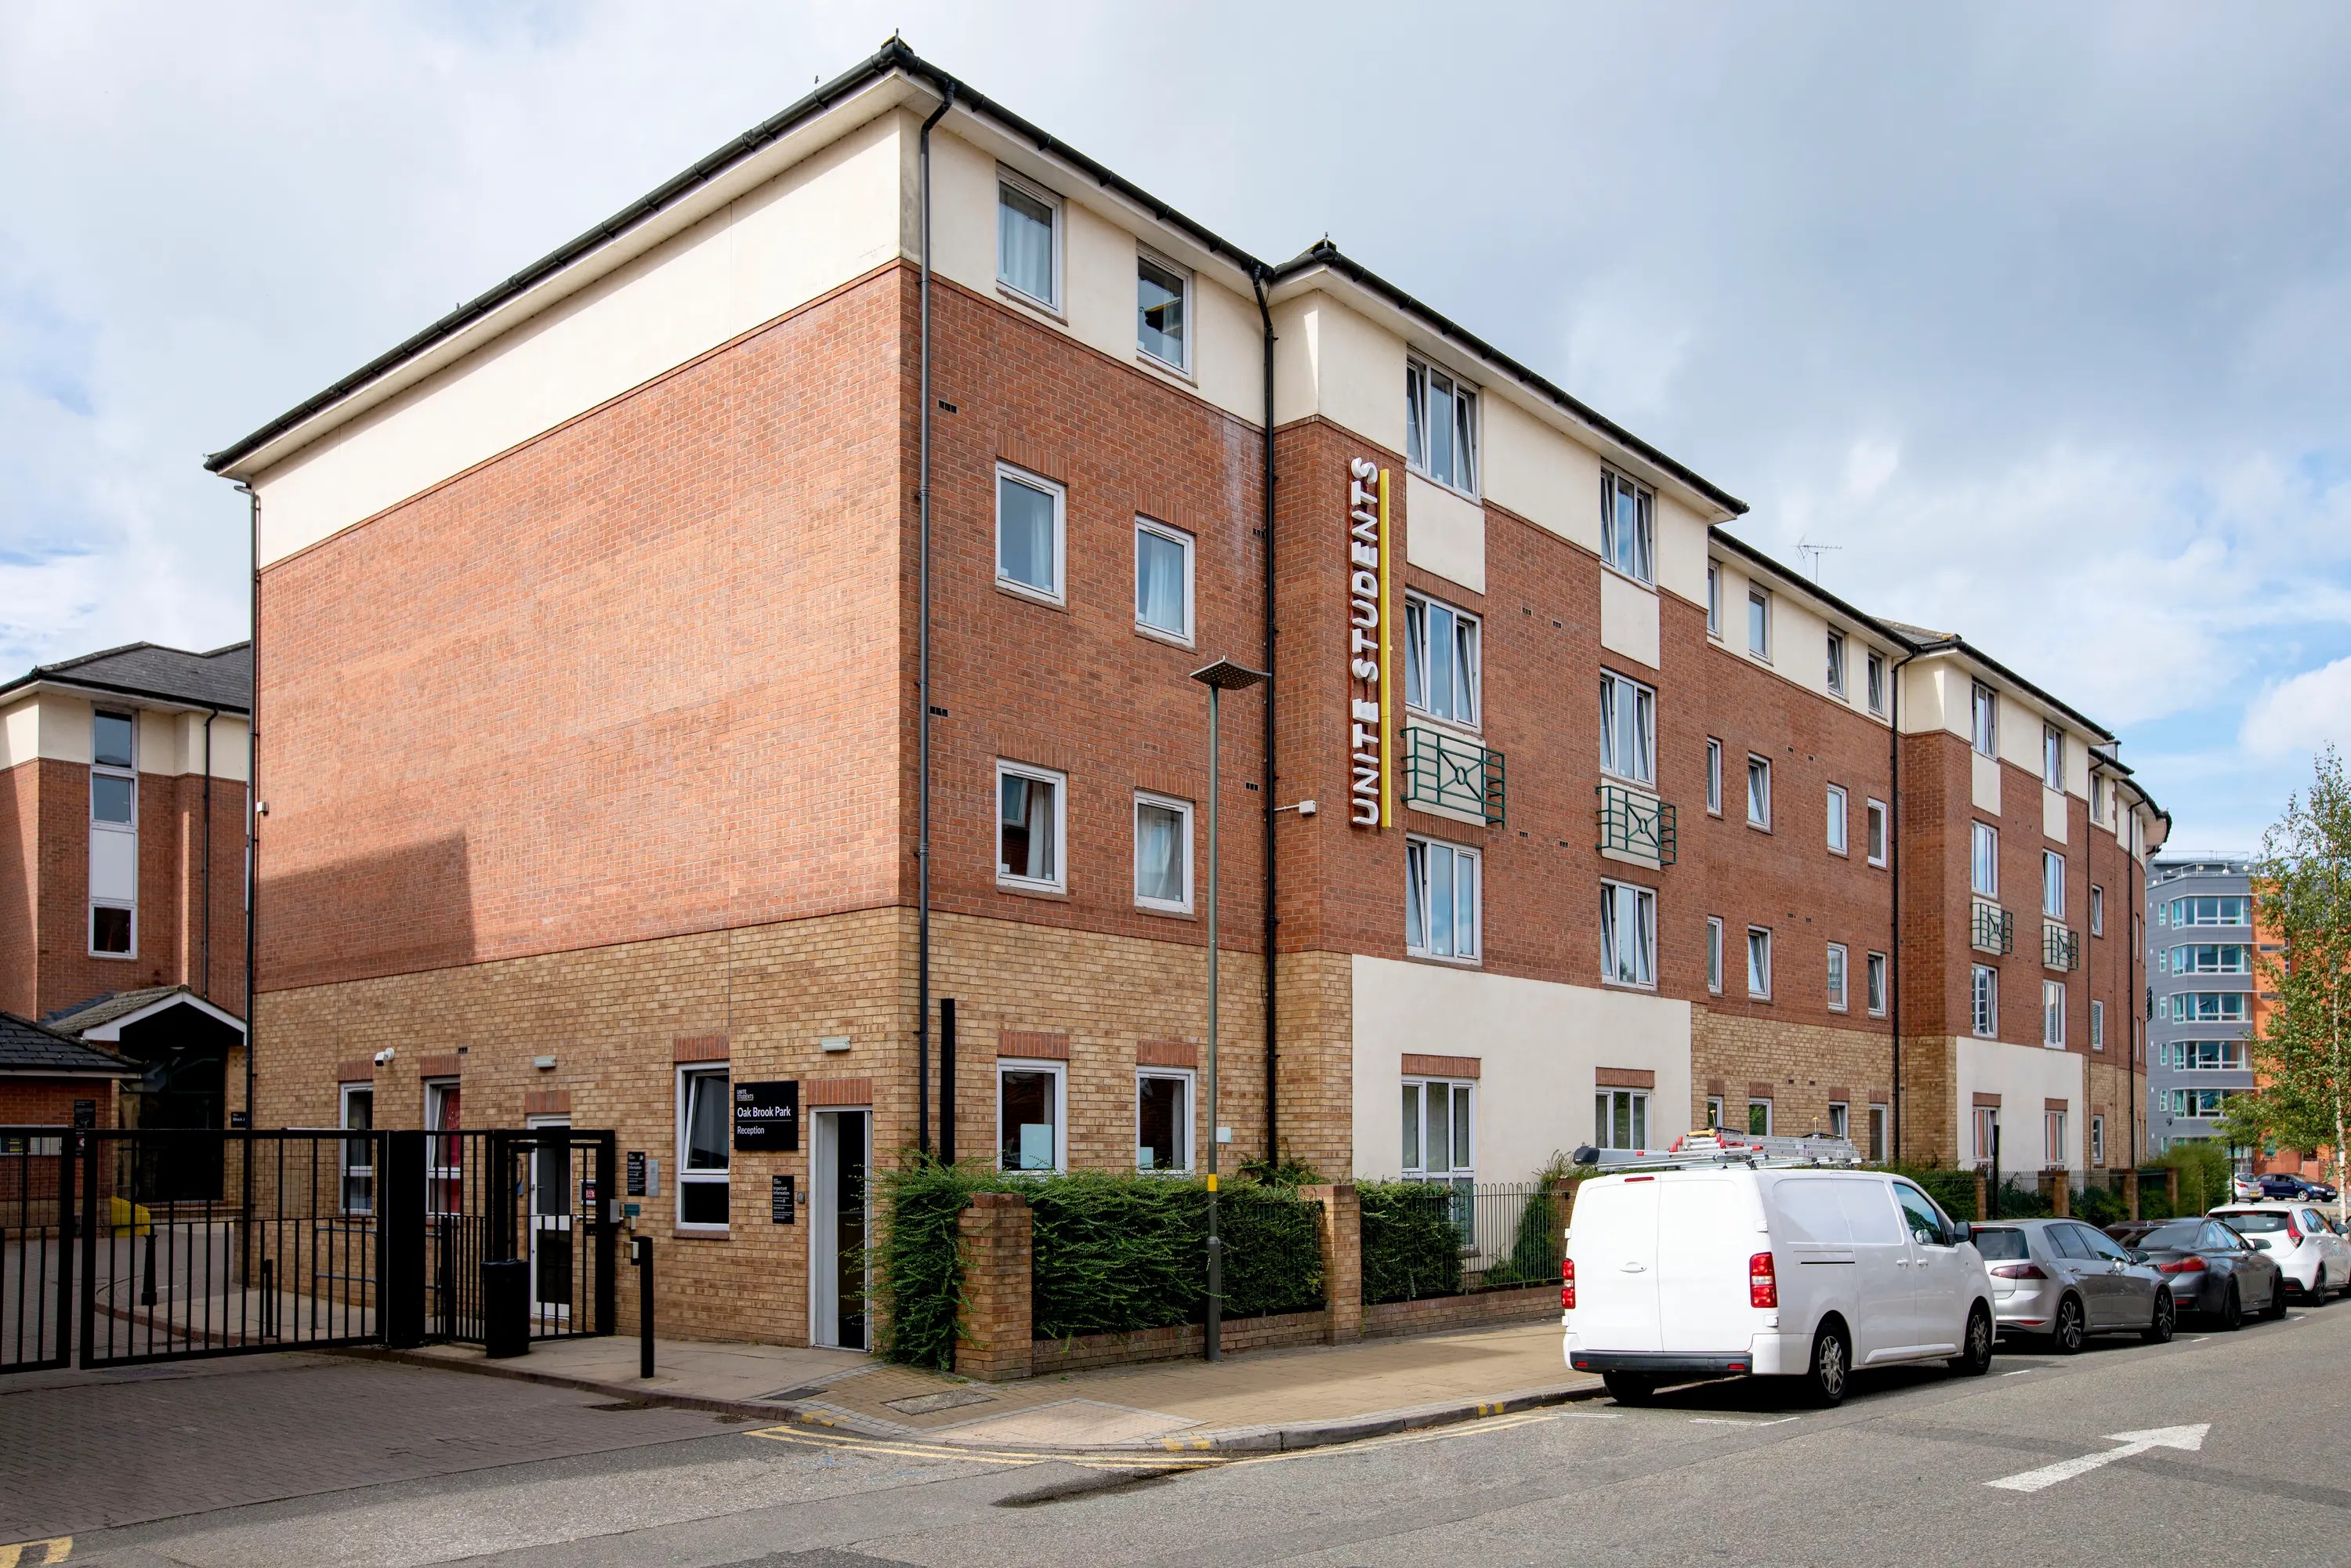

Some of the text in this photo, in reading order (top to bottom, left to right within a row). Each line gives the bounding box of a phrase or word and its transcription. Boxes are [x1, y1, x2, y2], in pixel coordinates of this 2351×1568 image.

[1349, 456, 1379, 826] UNITE STUDENTS
[737, 1105, 792, 1117] Oak Brook Park
[737, 1125, 765, 1136] Reception
